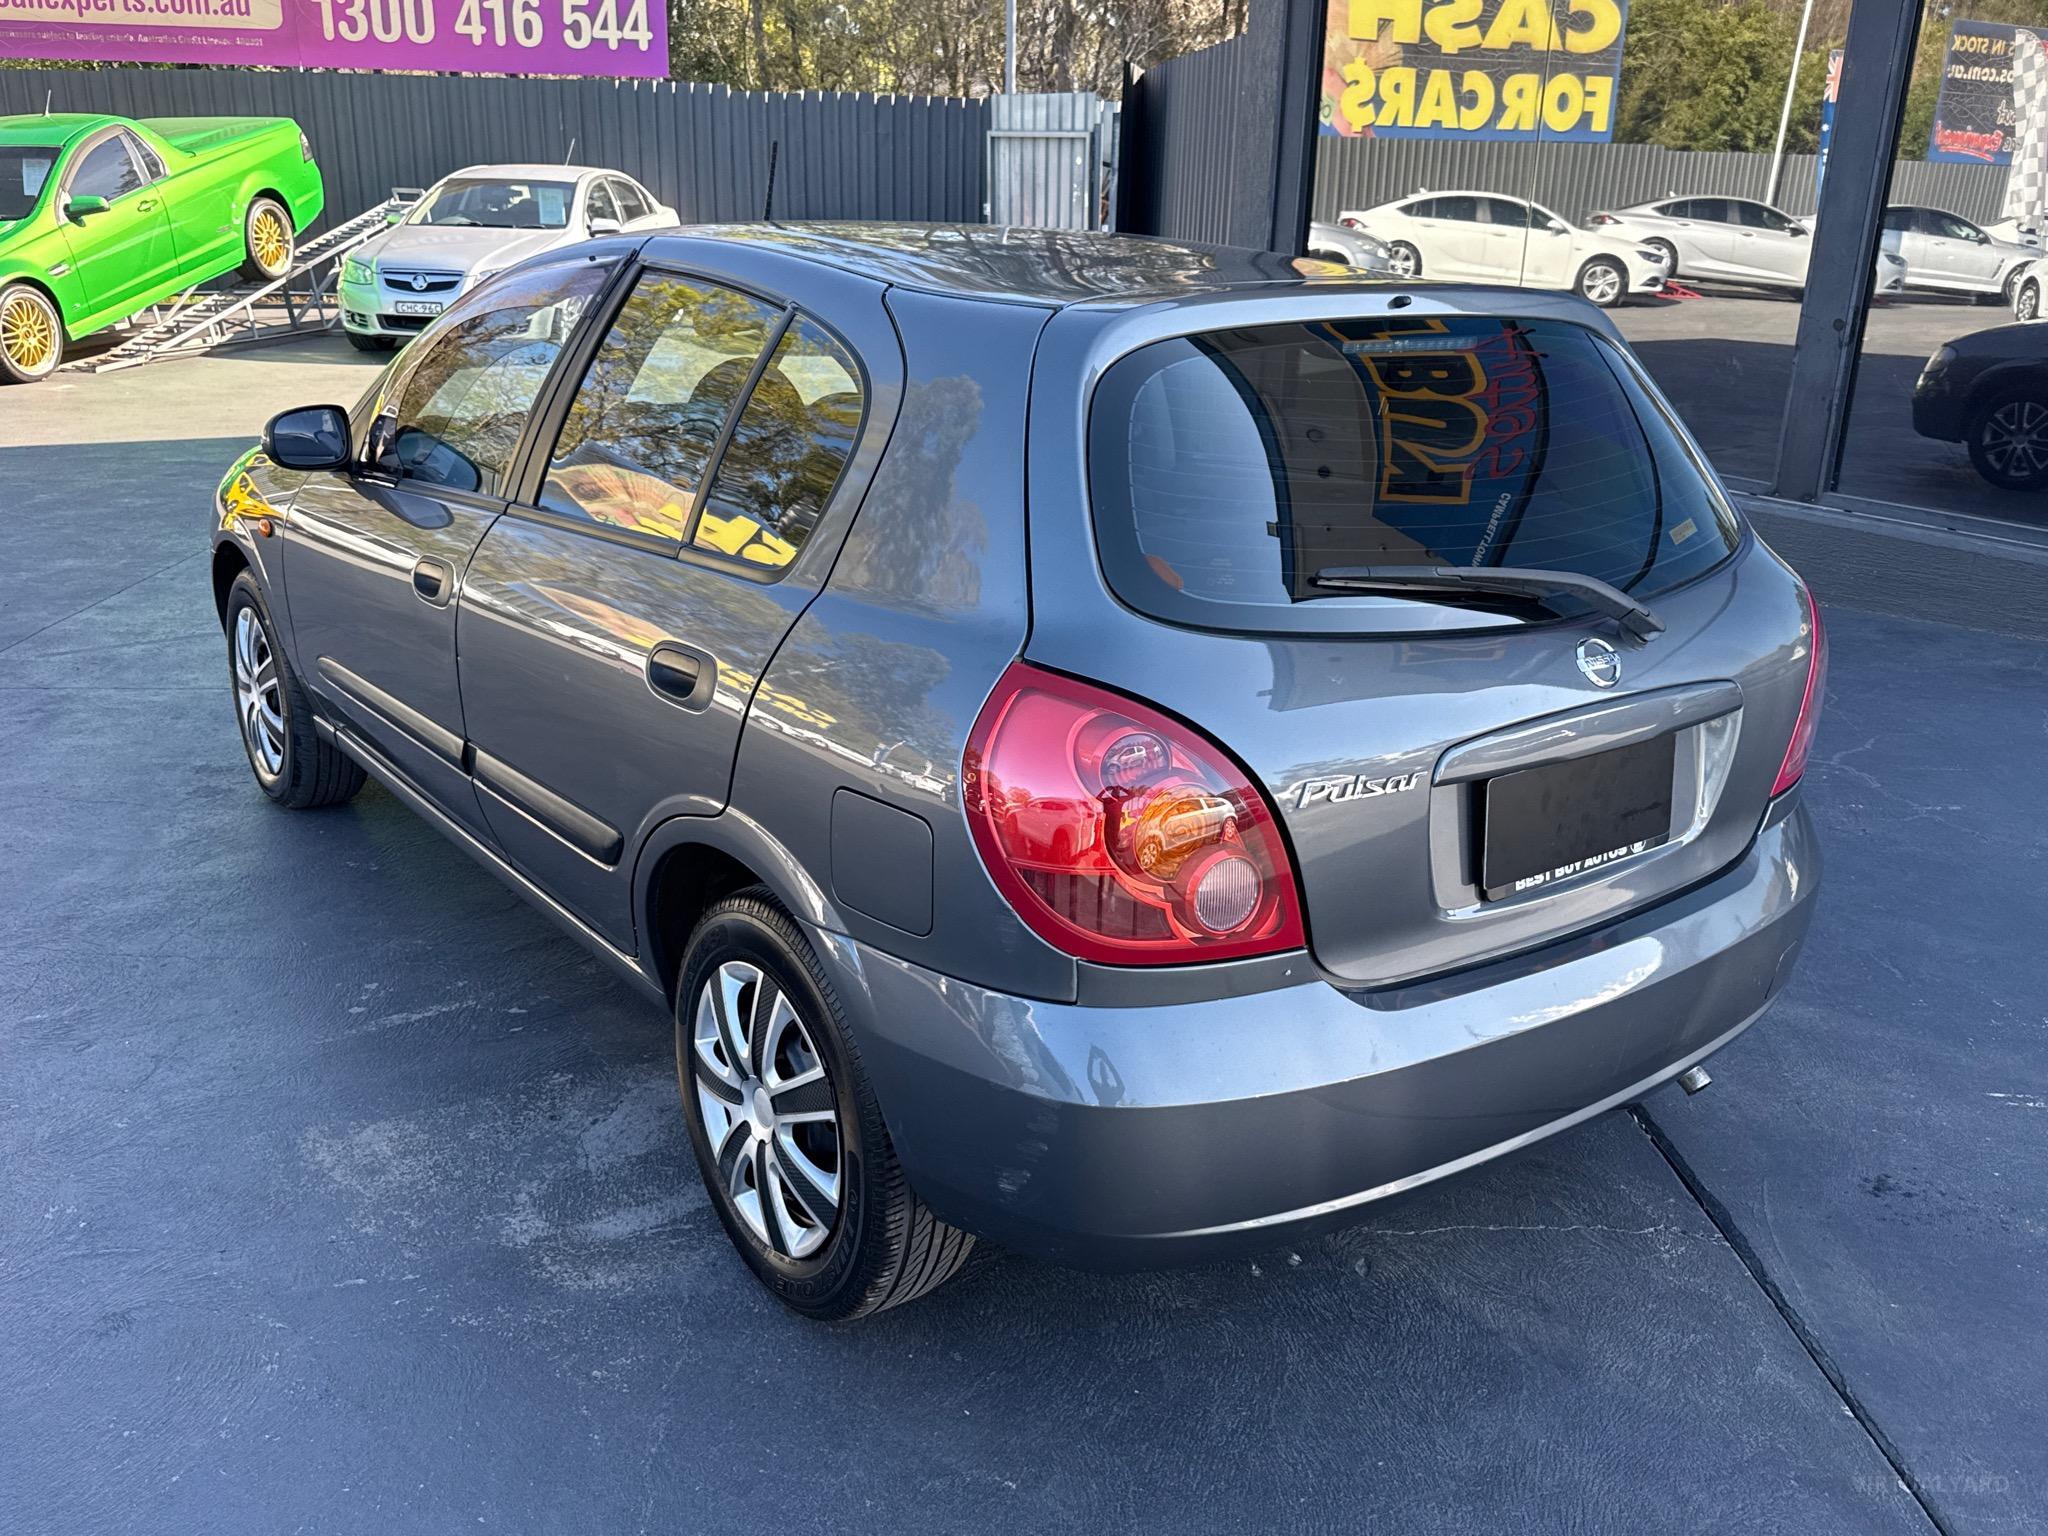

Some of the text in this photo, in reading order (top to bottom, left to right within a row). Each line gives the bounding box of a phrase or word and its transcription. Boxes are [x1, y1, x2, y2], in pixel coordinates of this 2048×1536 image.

[310, 0, 654, 51] 1300 416 544
[1296, 771, 1428, 809] Pulsar
[1515, 846, 1628, 891] BEST BUY AUTOS
